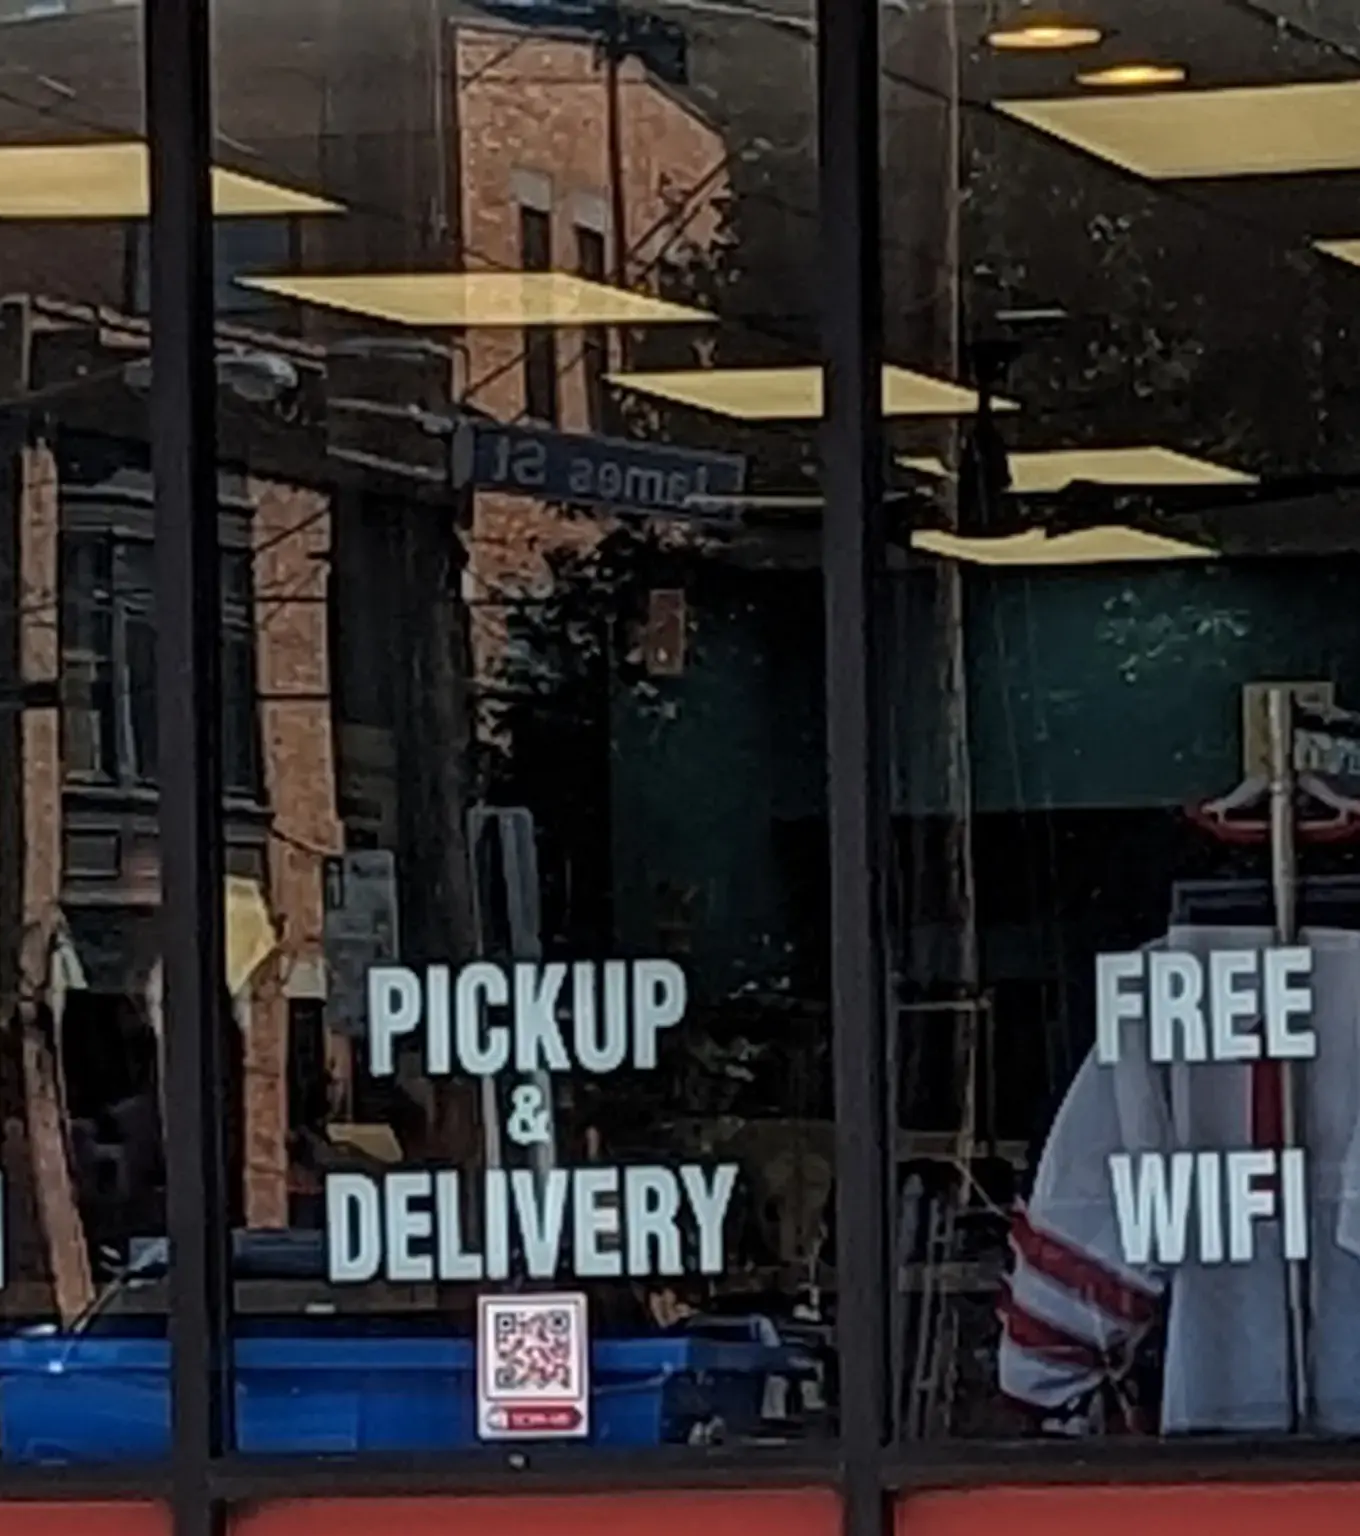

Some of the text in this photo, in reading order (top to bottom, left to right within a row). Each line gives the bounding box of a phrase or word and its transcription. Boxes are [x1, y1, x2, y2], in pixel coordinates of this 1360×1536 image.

[368, 960, 687, 1076] PICKUP
[1095, 946, 1317, 1064] FREE
[507, 1084, 553, 1146] &
[326, 1164, 739, 1282] DELIVERY
[1108, 1147, 1309, 1265] WIFI
